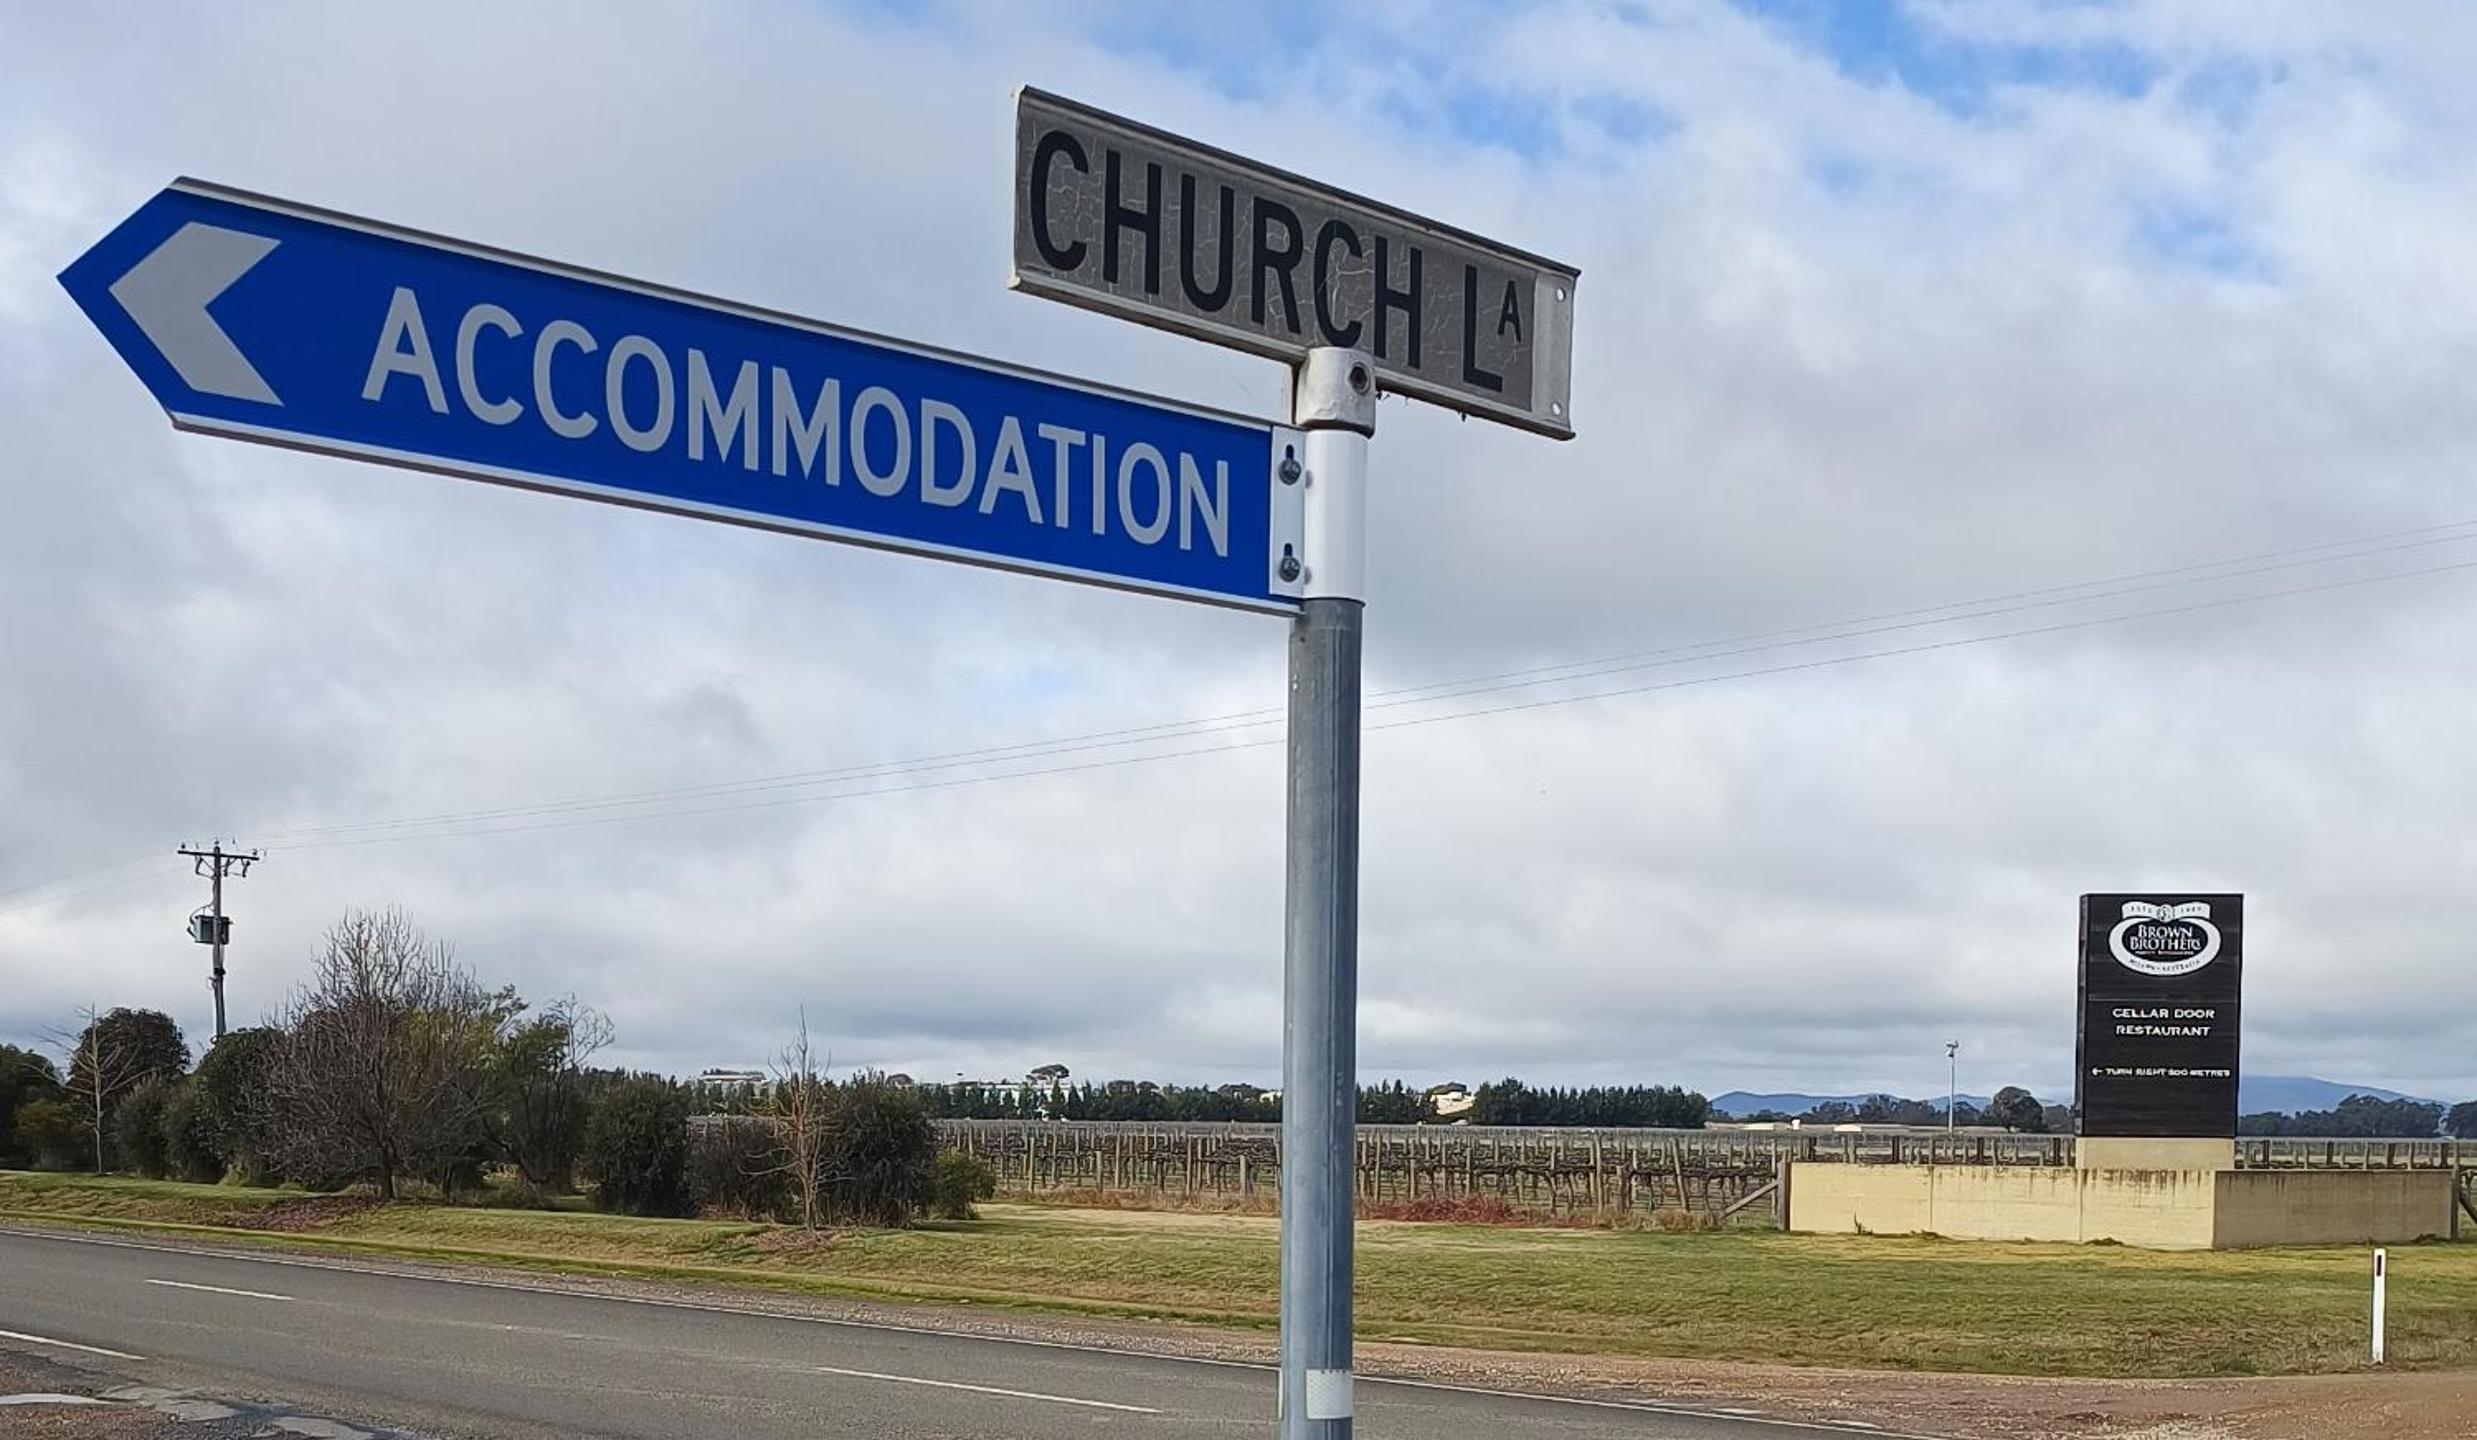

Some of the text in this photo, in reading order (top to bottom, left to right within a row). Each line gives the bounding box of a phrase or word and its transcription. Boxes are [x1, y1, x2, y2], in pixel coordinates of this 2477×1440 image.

[1029, 129, 1423, 370] CHURCH
[362, 286, 1230, 558] ACCOMMODATION
[2137, 924, 2193, 939] BROWN
[2112, 1008, 2216, 1019] CELLAR DOOR
[2115, 1025, 2211, 1037] RESTAURANT
